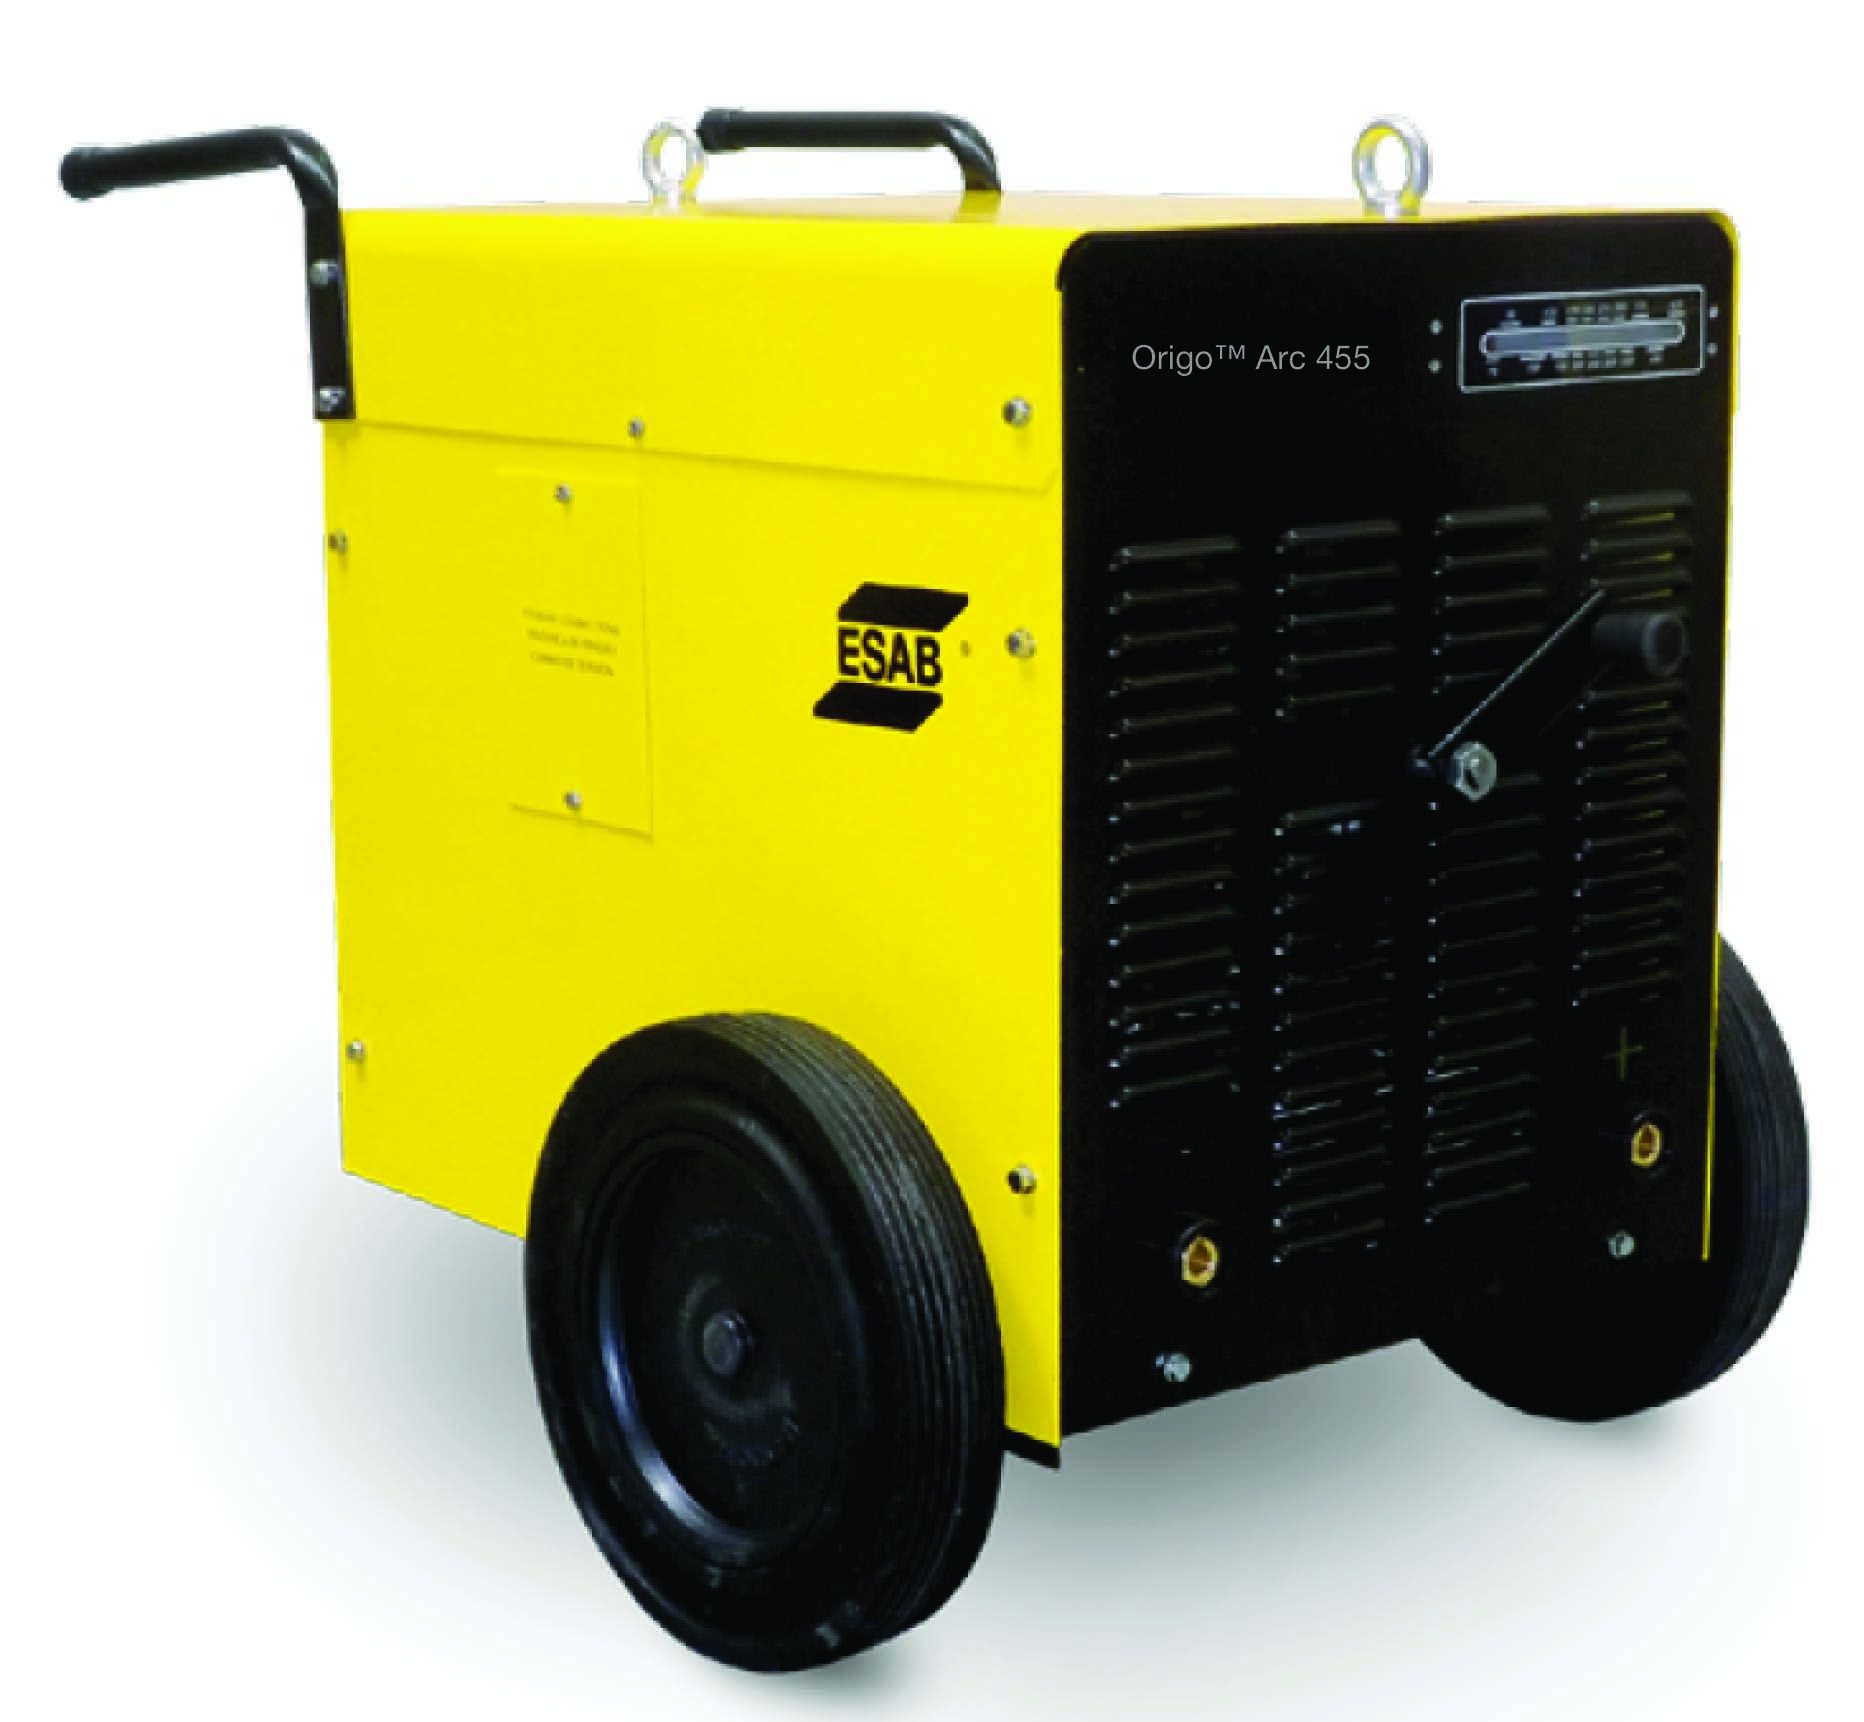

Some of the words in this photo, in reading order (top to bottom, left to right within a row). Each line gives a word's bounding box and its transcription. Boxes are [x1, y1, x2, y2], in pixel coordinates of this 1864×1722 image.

[1256, 345, 1306, 370] Arc
[1316, 345, 1370, 370] 455
[838, 629, 943, 686] ESAB
